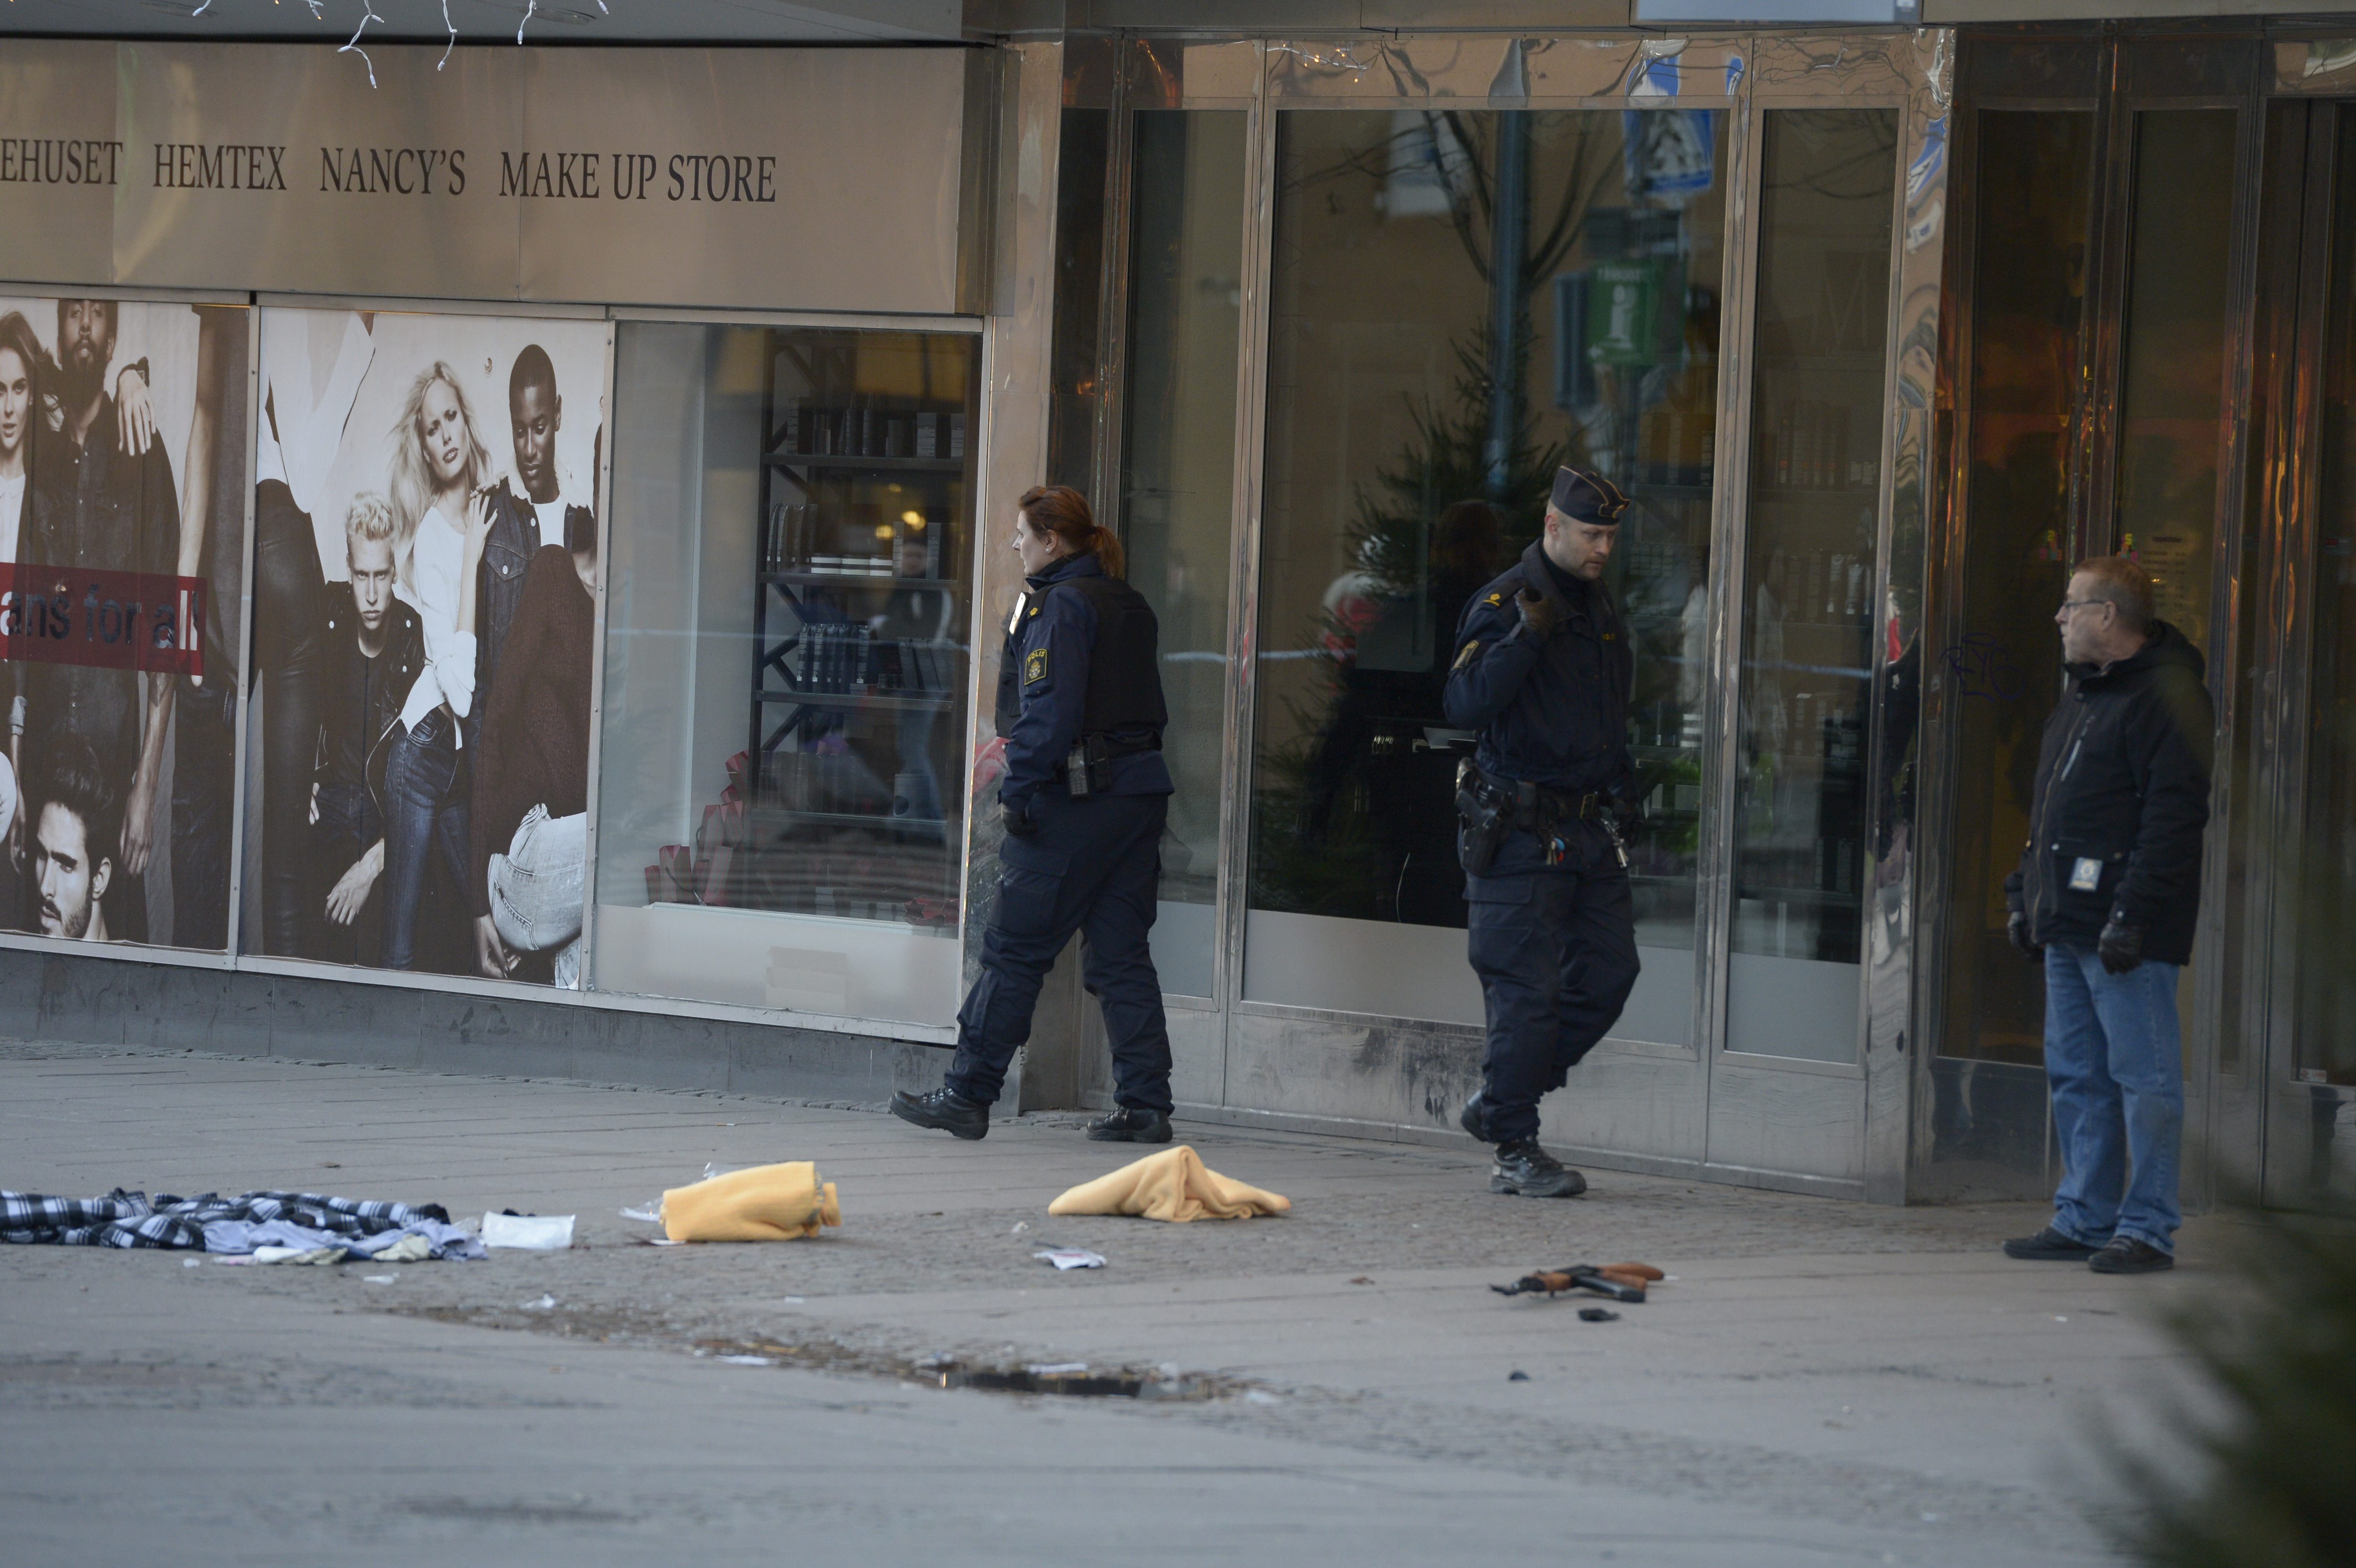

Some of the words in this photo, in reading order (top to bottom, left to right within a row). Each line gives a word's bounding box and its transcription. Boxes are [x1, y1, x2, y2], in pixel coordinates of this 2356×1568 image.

[0, 138, 123, 185] EHUSET
[153, 143, 287, 189] HEMTEX
[319, 147, 466, 195] NANCY'S
[499, 152, 600, 199] MAKE
[612, 154, 656, 199] UP
[667, 154, 776, 203] STORE
[0, 591, 70, 639] ans
[84, 584, 142, 644] for
[154, 590, 198, 651] all
[1027, 651, 1046, 664] POLIS
